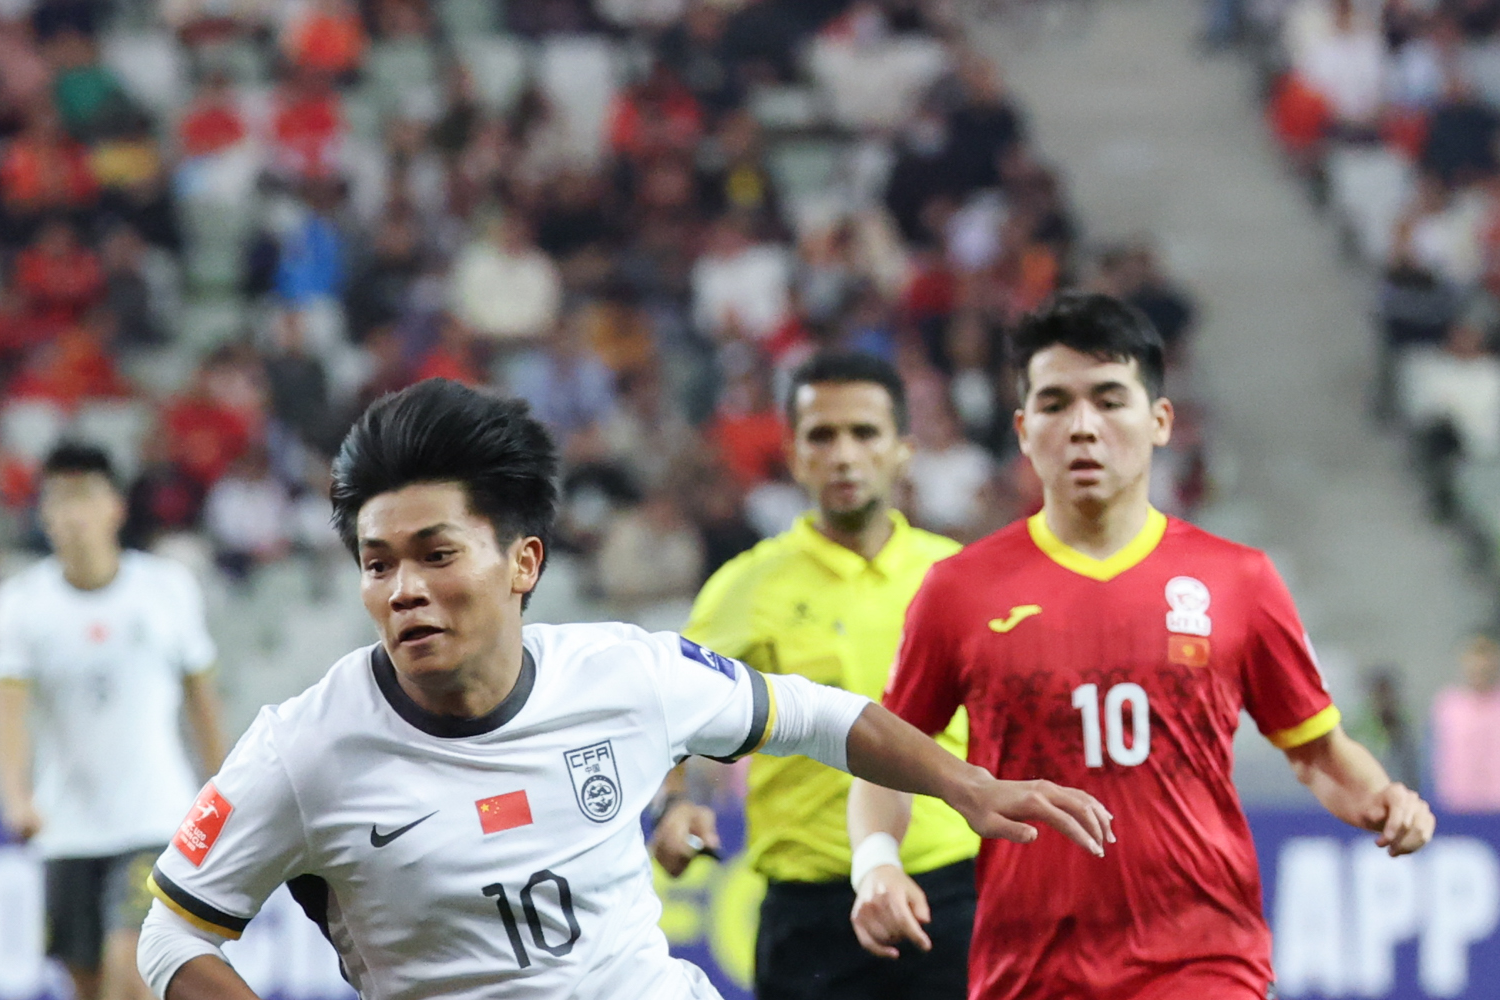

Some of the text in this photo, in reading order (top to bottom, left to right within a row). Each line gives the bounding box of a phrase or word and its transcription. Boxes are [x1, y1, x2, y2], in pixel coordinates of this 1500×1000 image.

[569, 746, 610, 769] CFA
[1072, 682, 1151, 767] 10
[481, 868, 581, 969] 10
[1274, 836, 1498, 998] APP
